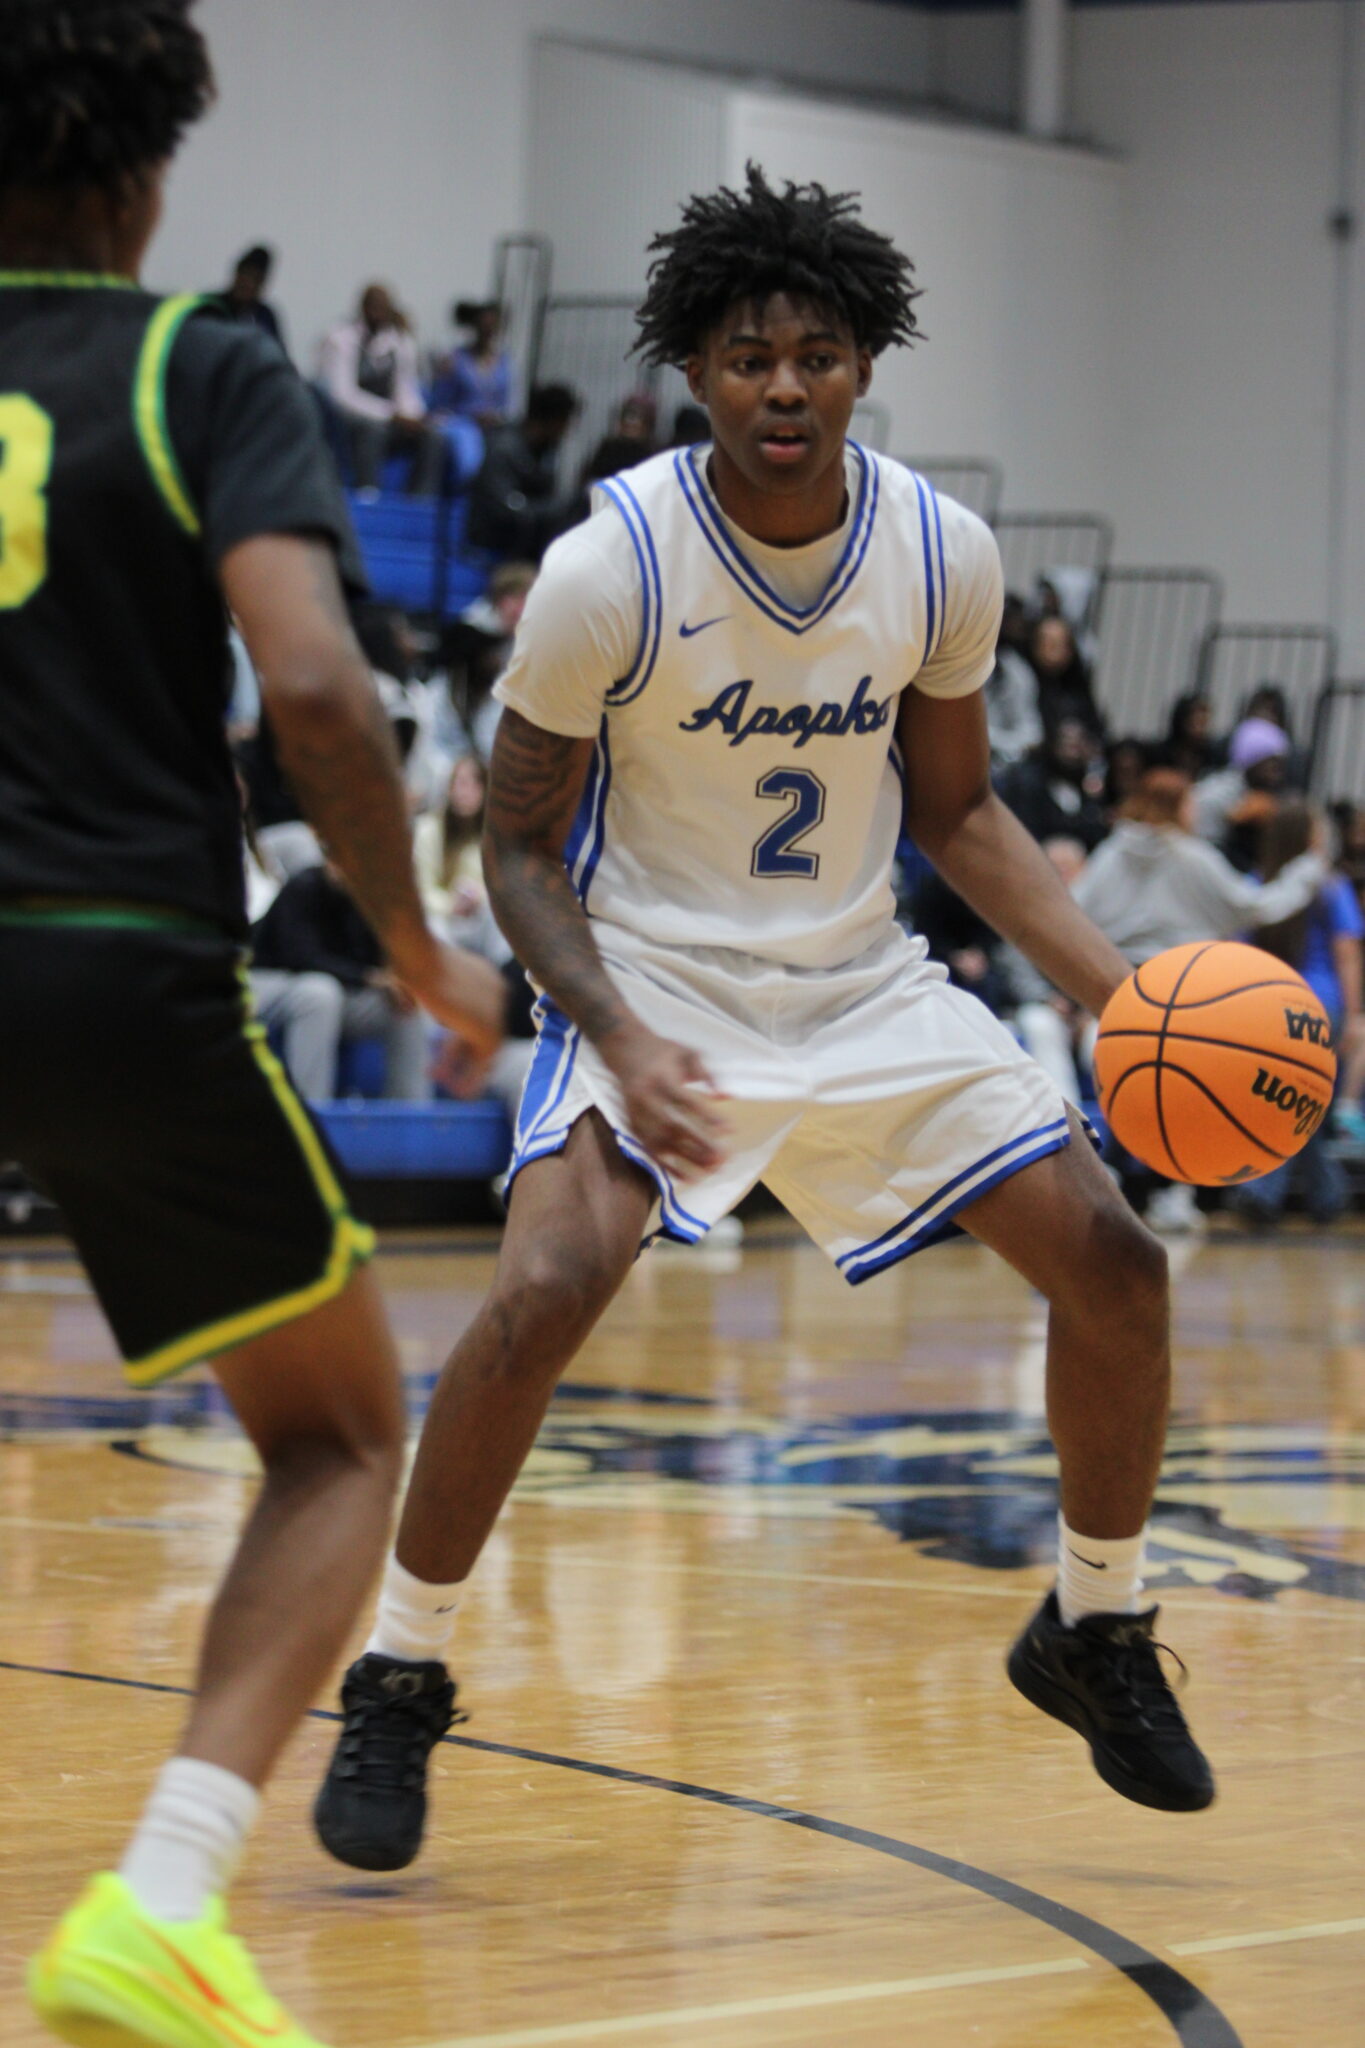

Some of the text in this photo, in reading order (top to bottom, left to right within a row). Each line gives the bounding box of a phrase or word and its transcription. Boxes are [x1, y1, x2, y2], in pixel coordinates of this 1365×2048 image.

[750, 766, 826, 880] 2
[1284, 1008, 1336, 1054] CAA
[1252, 1067, 1326, 1136] ilson
